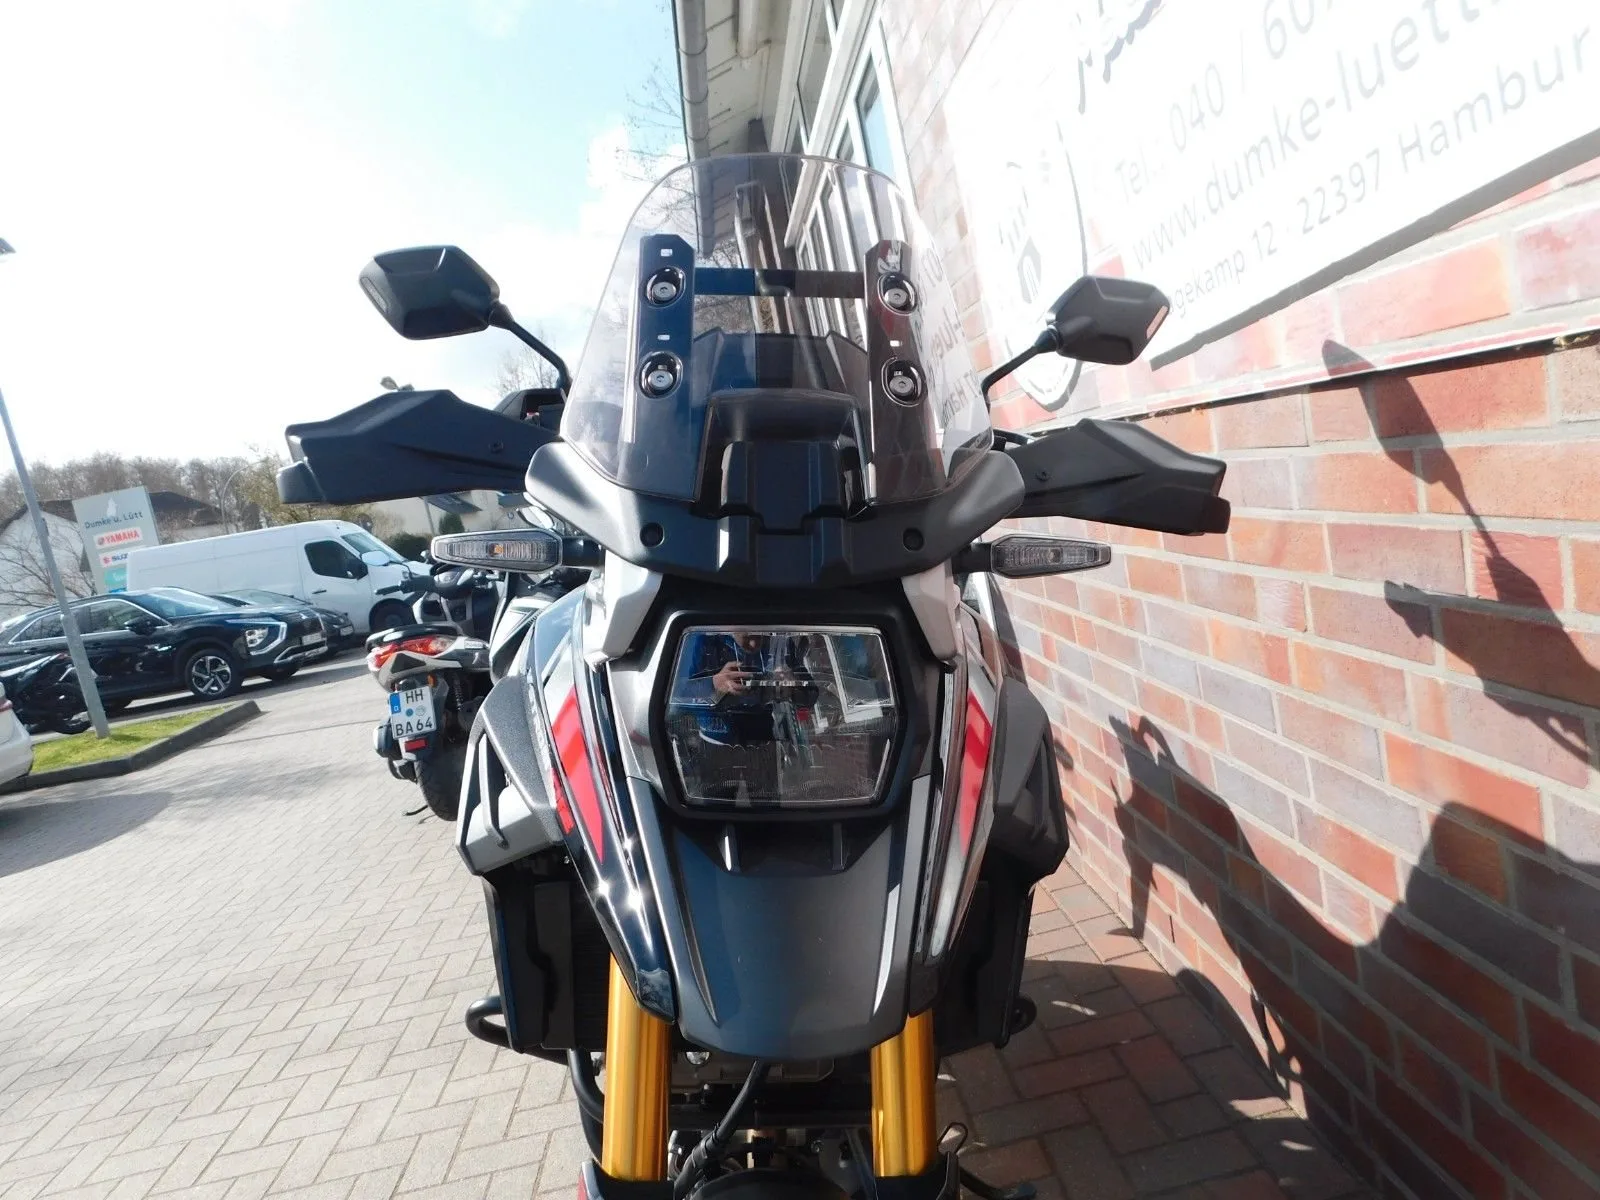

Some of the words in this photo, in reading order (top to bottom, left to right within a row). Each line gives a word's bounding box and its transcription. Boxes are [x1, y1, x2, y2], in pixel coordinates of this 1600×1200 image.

[1169, 61, 1225, 154] 040
[1170, 249, 1247, 320] gekamp
[1249, 220, 1278, 262] 12
[1297, 147, 1382, 235] 22397
[1399, 25, 1591, 174] Hambur
[85, 516, 111, 529] Dumke
[123, 511, 143, 521] Lütt
[105, 530, 140, 544] YAMAHA
[405, 689, 424, 704] HH
